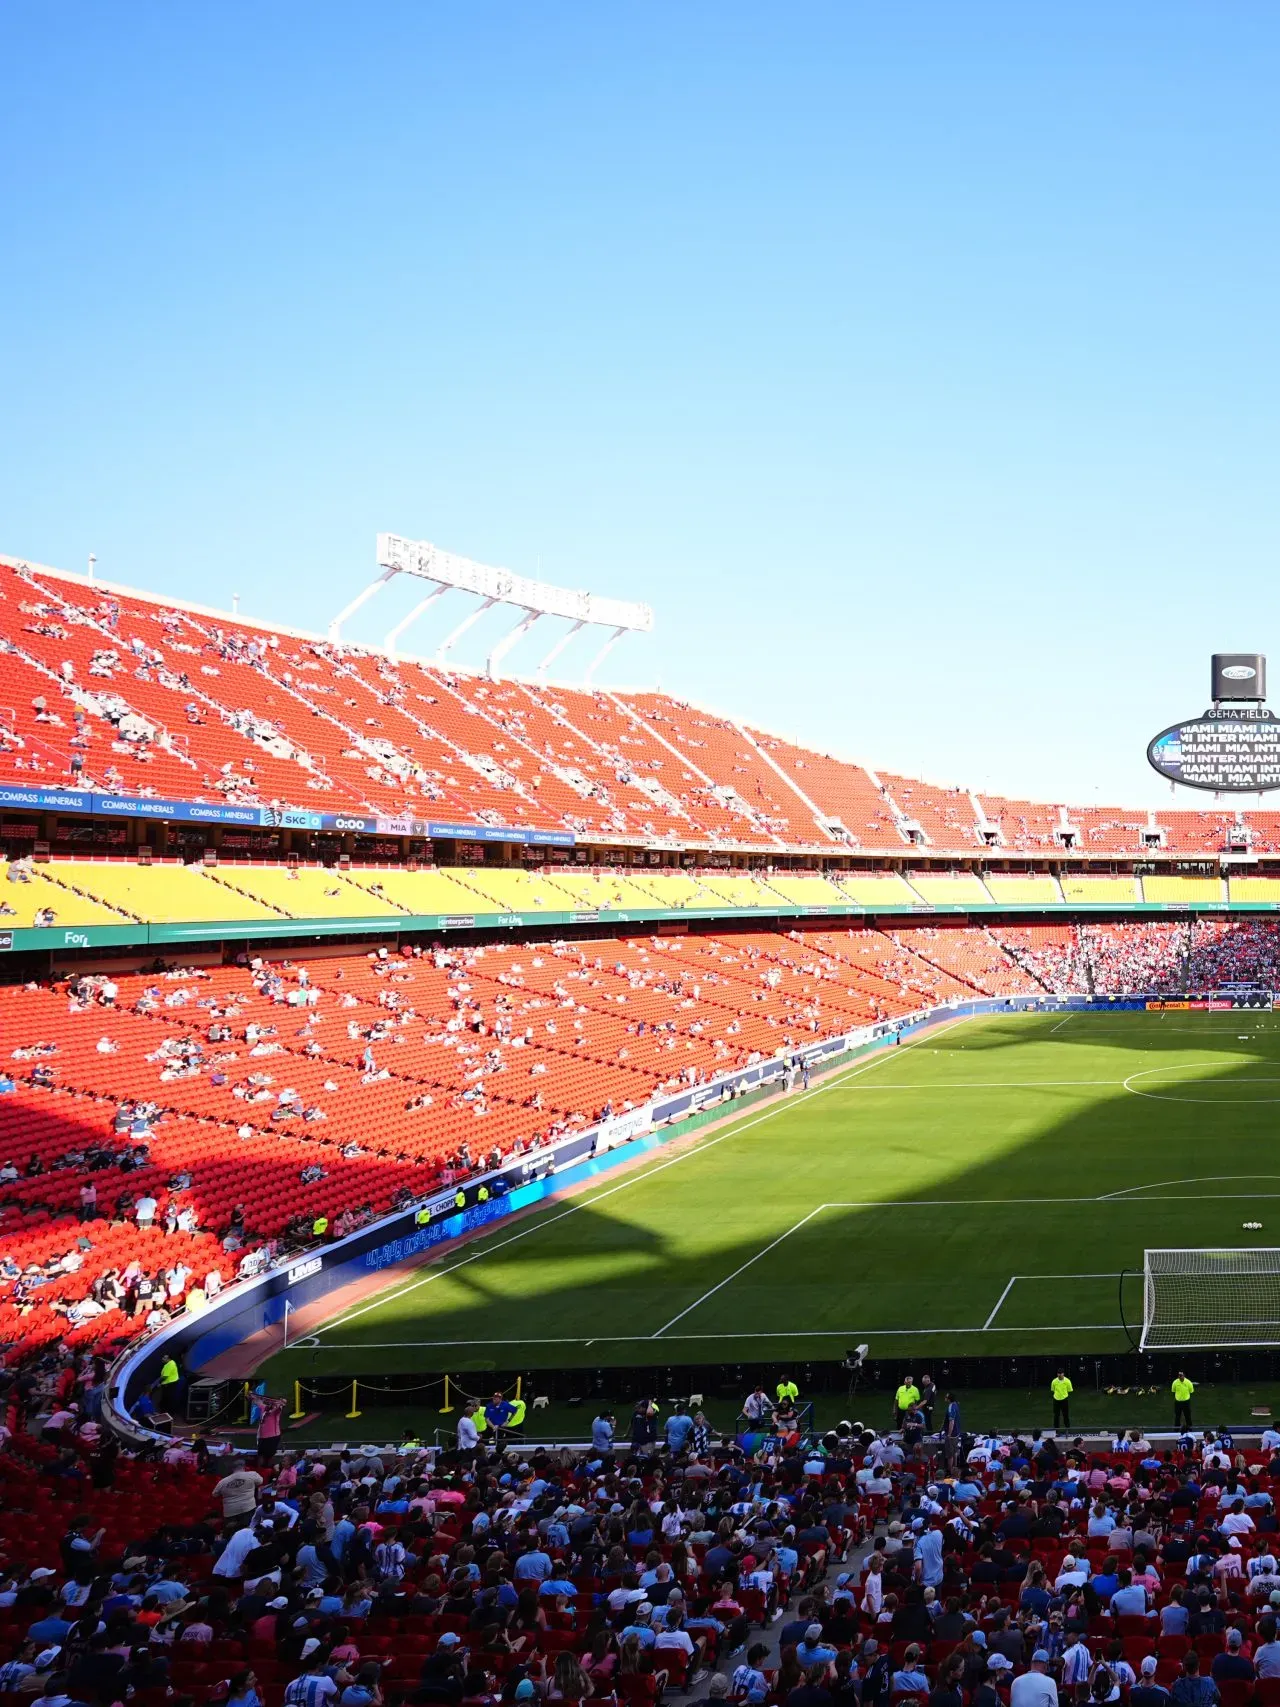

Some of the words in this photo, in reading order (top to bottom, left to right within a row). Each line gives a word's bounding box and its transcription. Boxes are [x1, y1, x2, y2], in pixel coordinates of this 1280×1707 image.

[1208, 709, 1238, 719] GEHA
[1240, 709, 1270, 719] FIELD
[1218, 725, 1257, 733] MIAMI
[1197, 734, 1237, 742] INTER
[1239, 734, 1278, 742] MIAMI
[1181, 744, 1220, 752] MIAMI
[1225, 744, 1250, 752] MIA
[1197, 755, 1237, 763] INTER
[1239, 755, 1278, 763] MIAMI
[1218, 765, 1257, 773] MIAMI
[1228, 774, 1253, 782] MIA
[43, 796, 83, 807] MINERALS
[101, 800, 137, 811] COMPASS
[141, 803, 175, 814] MINERALS
[189, 808, 221, 818] COMPASS
[224, 811, 254, 820] MINERALS
[285, 815, 306, 825] SKC
[335, 818, 365, 830] 0:00
[390, 823, 407, 832] MIA
[440, 918, 473, 928] enterprise
[498, 916, 508, 925] For
[64, 931, 86, 944] For
[288, 1256, 322, 1283] UMB
[762, 1441, 774, 1450] 18
